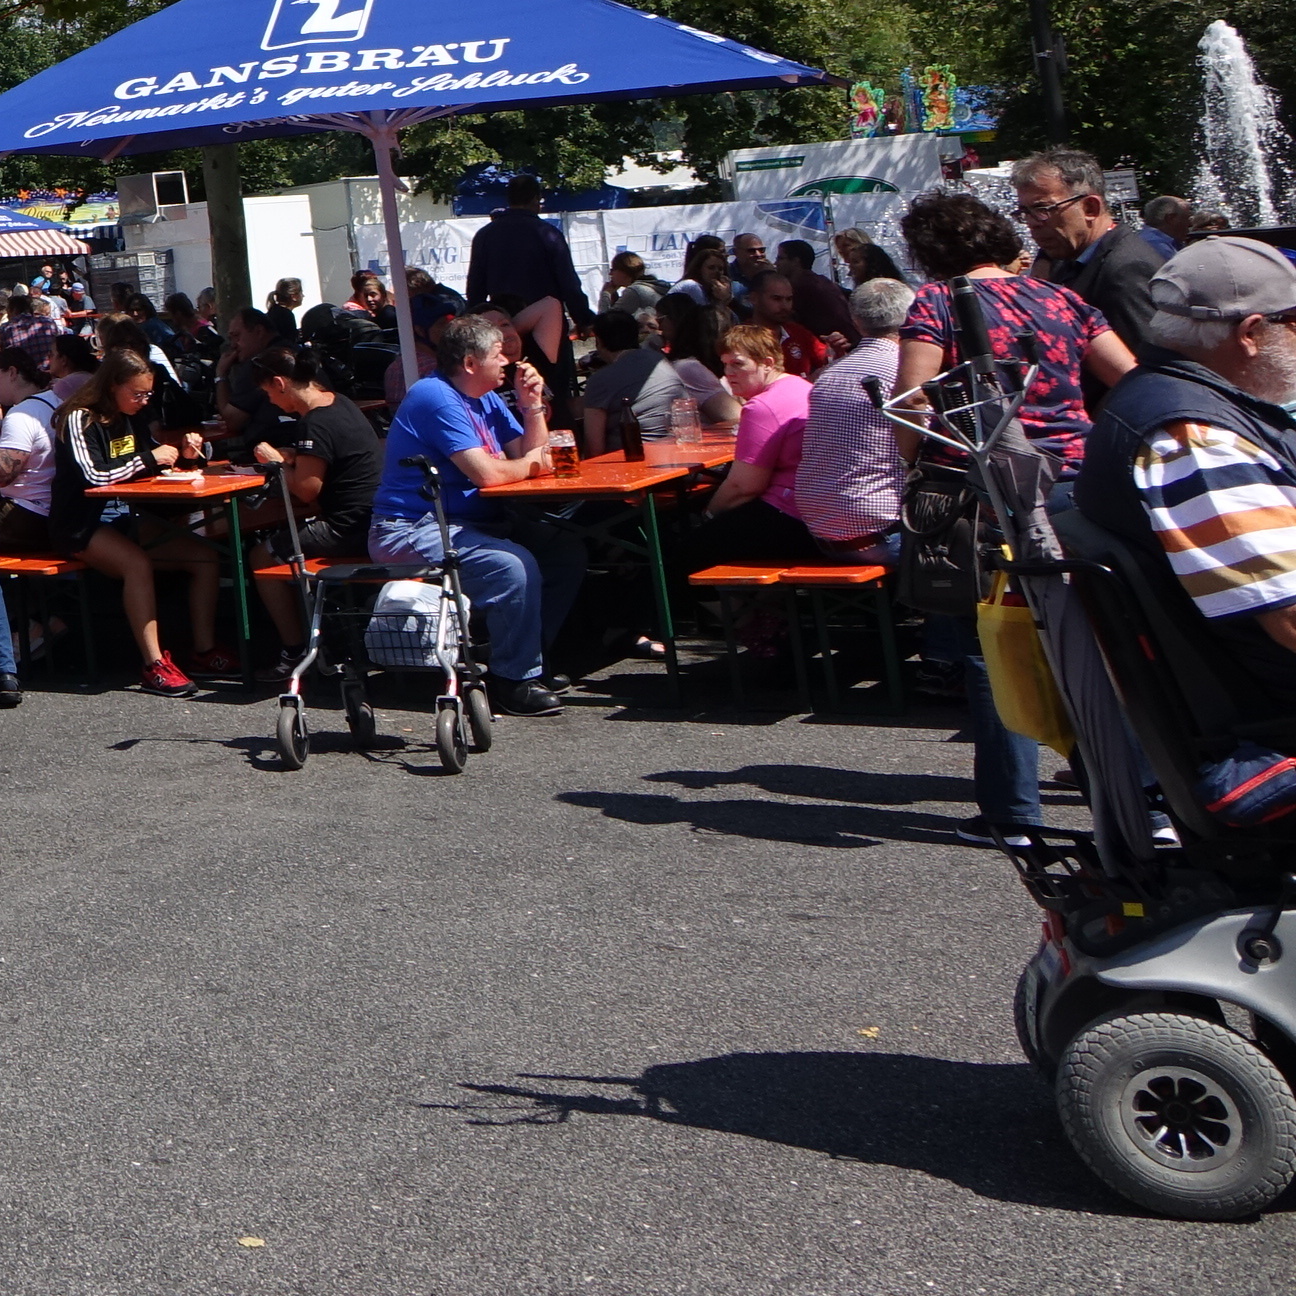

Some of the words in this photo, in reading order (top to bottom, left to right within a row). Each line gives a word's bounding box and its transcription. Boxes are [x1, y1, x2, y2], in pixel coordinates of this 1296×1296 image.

[23, 86, 268, 139] Neumarkt's
[277, 78, 397, 105] guter
[392, 62, 590, 99] Schluck
[114, 37, 510, 100] GANSBRÄU
